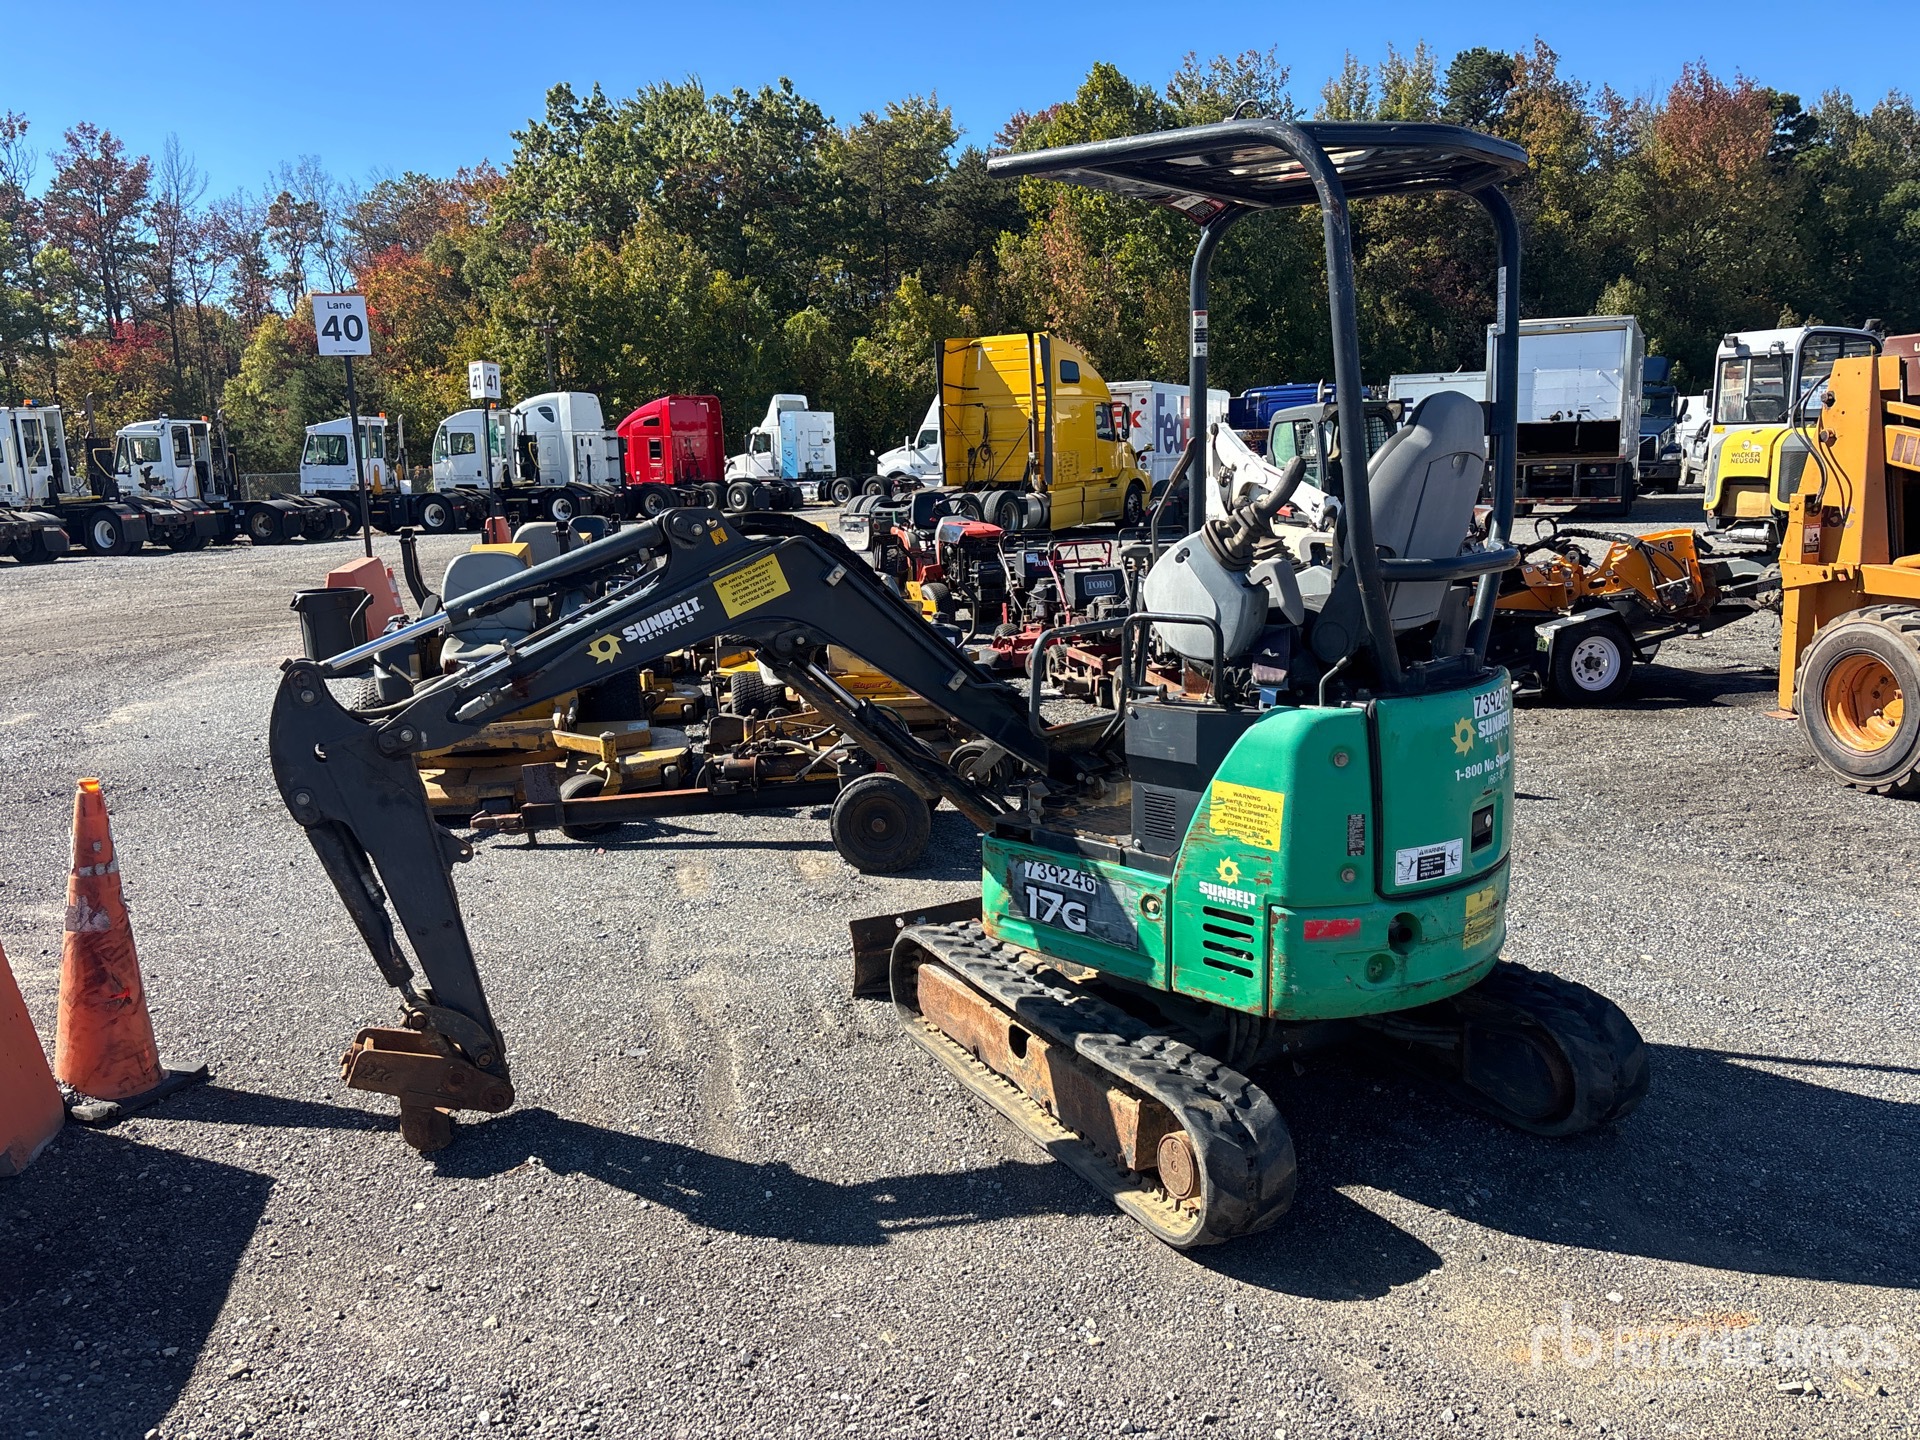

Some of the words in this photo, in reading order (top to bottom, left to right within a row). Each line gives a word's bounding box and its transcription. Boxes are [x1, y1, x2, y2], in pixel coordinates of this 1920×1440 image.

[326, 300, 352, 310] Lane
[321, 314, 364, 342] 40
[472, 375, 482, 390] 41
[487, 375, 497, 390] 41
[1156, 393, 1190, 454] FedE
[752, 560, 773, 572] OPERATE
[742, 569, 769, 584] EQUIPMENT
[731, 586, 749, 596] WITHIN
[759, 575, 771, 584] FEET
[739, 586, 764, 600] OVERHEAD
[765, 580, 776, 588] HIGH
[1086, 580, 1112, 589] TORO
[739, 595, 760, 606] VOLTAGE
[761, 588, 774, 596] LINES
[622, 596, 700, 642] SUNBELT
[639, 615, 694, 644] RENTALS
[1455, 762, 1482, 781] 1-800
[1484, 758, 1494, 772] No
[1233, 792, 1261, 802] WARNING
[1223, 812, 1242, 820] WITHIN
[1238, 808, 1268, 818] EQUIPMENT
[1253, 804, 1278, 813] OPERATE
[1227, 820, 1256, 830] OVERHEAD
[1424, 846, 1446, 854] WARNING
[1025, 861, 1095, 892] 739246
[1198, 881, 1257, 906] SUNBELT
[1026, 885, 1086, 932] 17G
[1207, 894, 1248, 910] RENTALS
